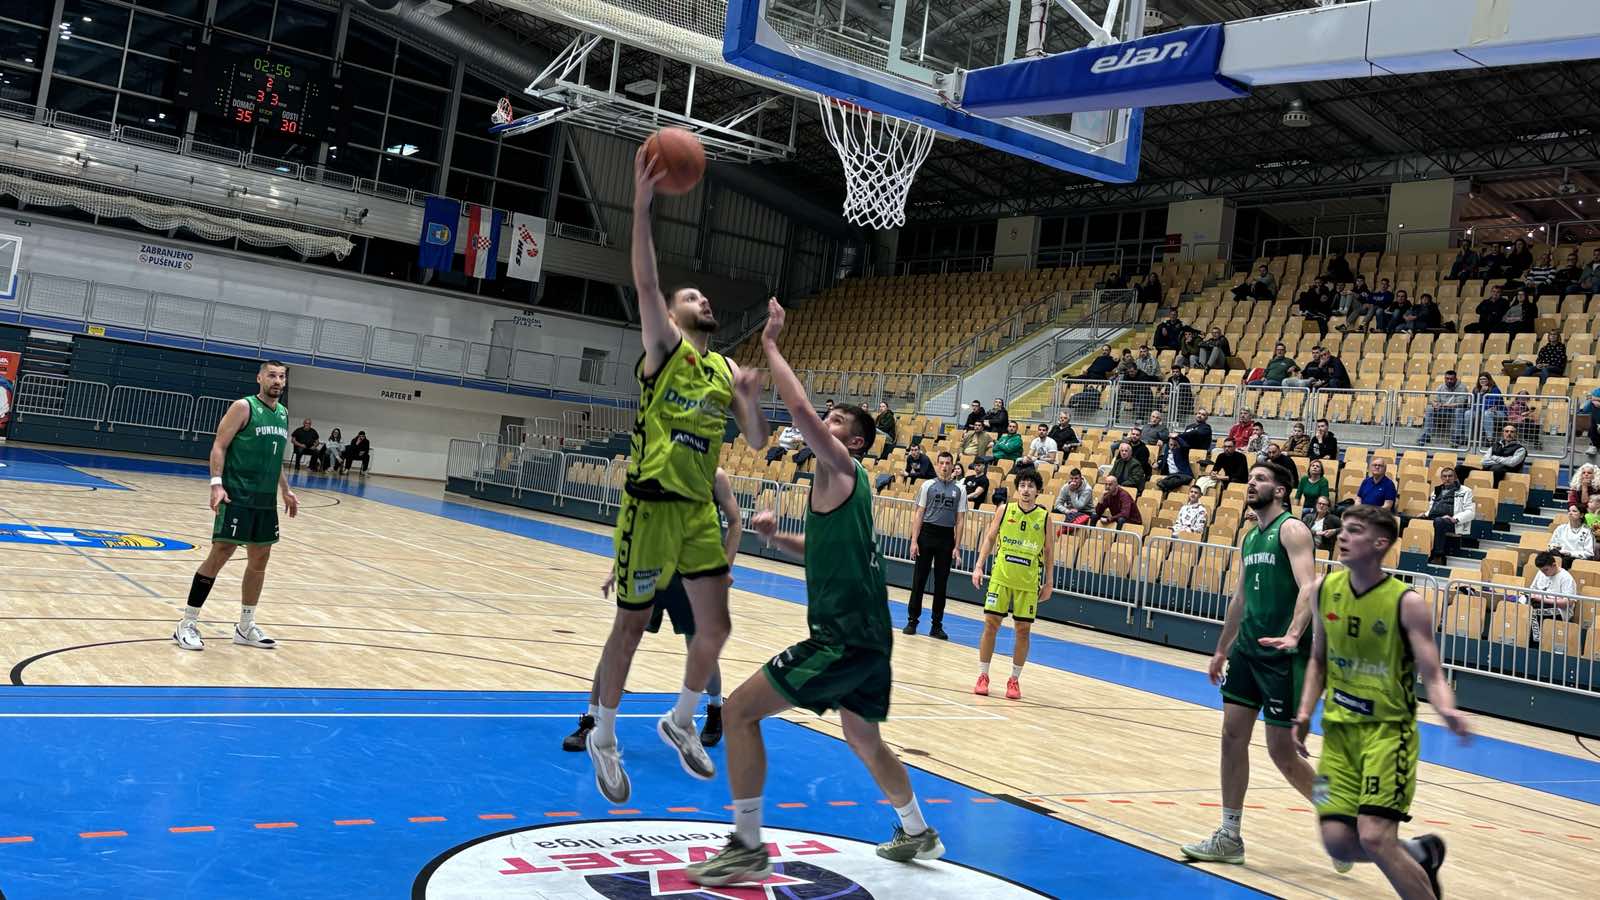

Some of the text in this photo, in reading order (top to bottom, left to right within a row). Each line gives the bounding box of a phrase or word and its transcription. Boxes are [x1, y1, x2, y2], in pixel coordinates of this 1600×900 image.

[1090, 41, 1188, 74] elan
[254, 58, 291, 78] 02:56
[235, 108, 252, 122] 35
[280, 119, 297, 133] 30
[140, 245, 194, 261] ZABRANJENO
[148, 255, 183, 269] PUŠENJE
[380, 390, 406, 400] PARTER
[272, 441, 278, 455] 7
[230, 524, 237, 537] 7
[1253, 572, 1260, 590] 5
[1364, 776, 1380, 796] 13
[533, 837, 605, 849] liga
